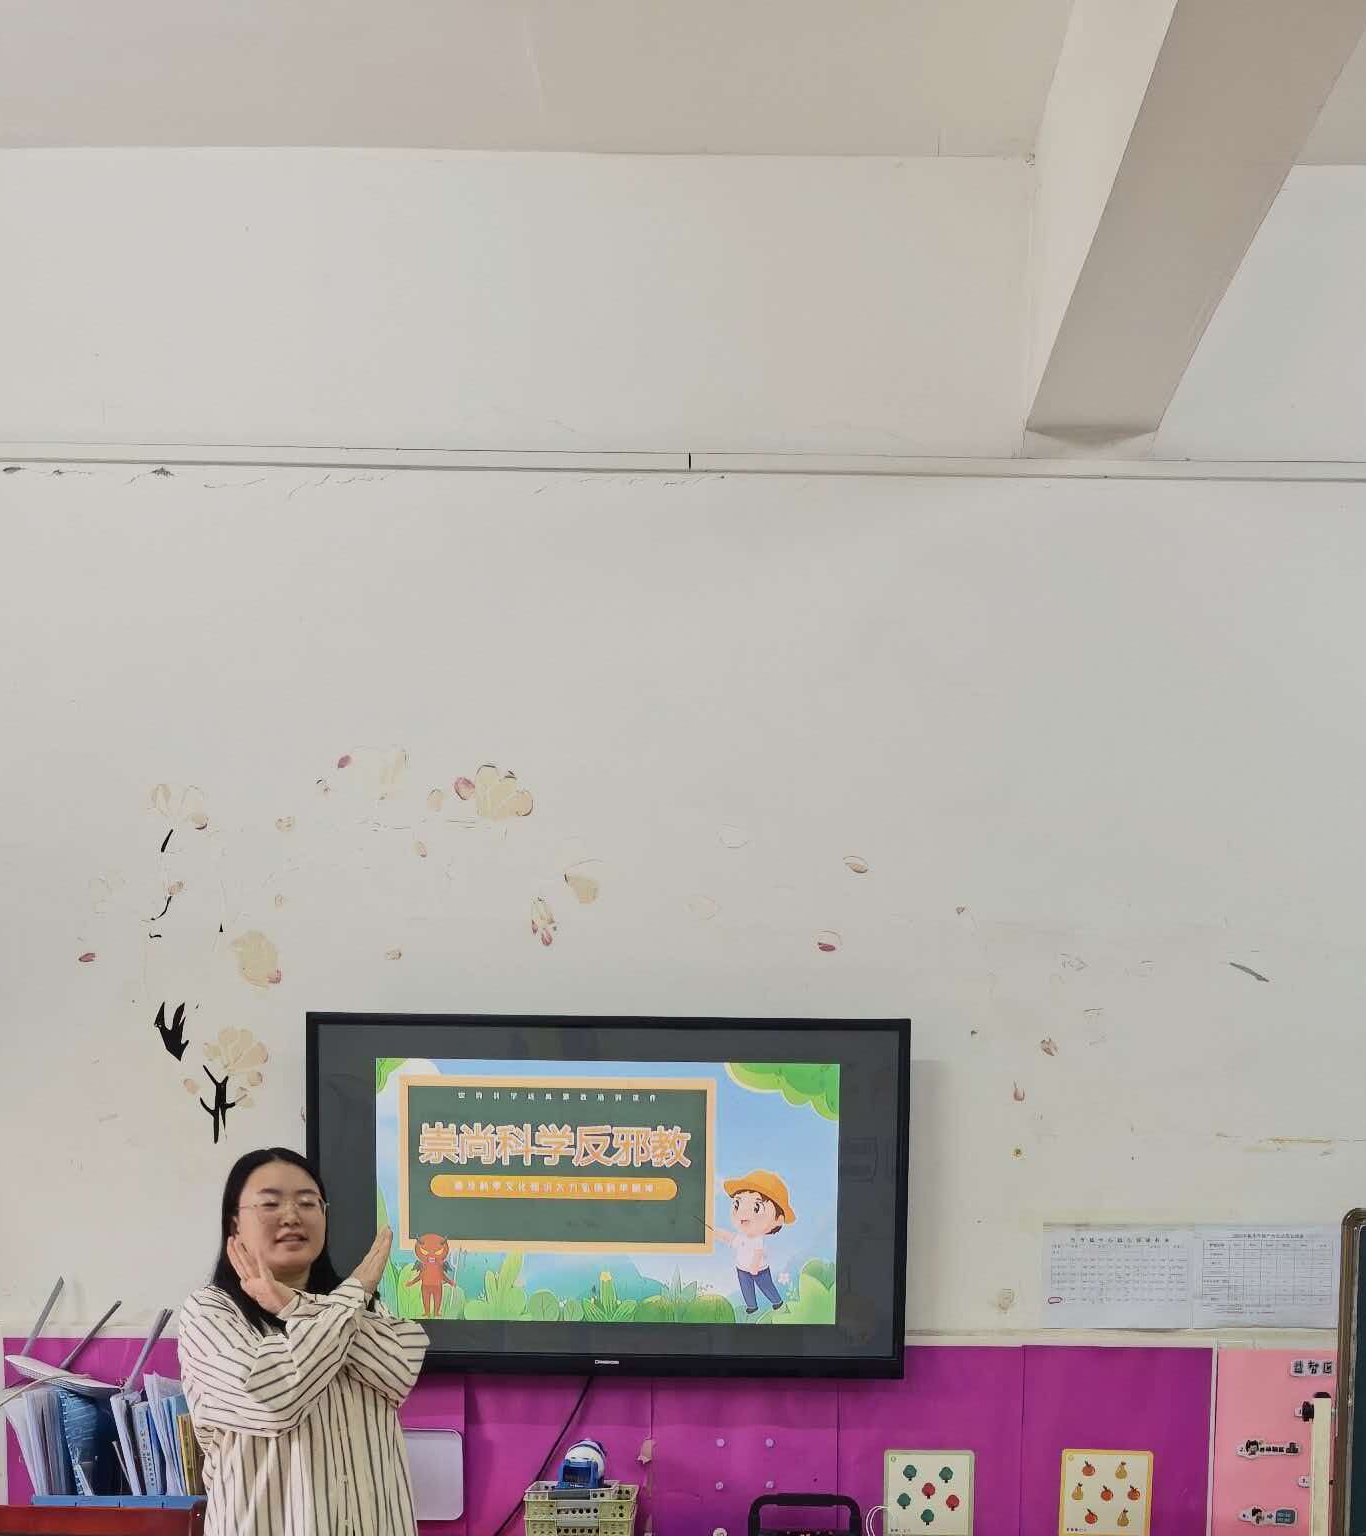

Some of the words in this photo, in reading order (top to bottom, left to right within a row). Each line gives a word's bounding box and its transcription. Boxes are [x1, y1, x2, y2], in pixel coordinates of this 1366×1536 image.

[419, 1122, 692, 1167] 崇尚科学反邪教
